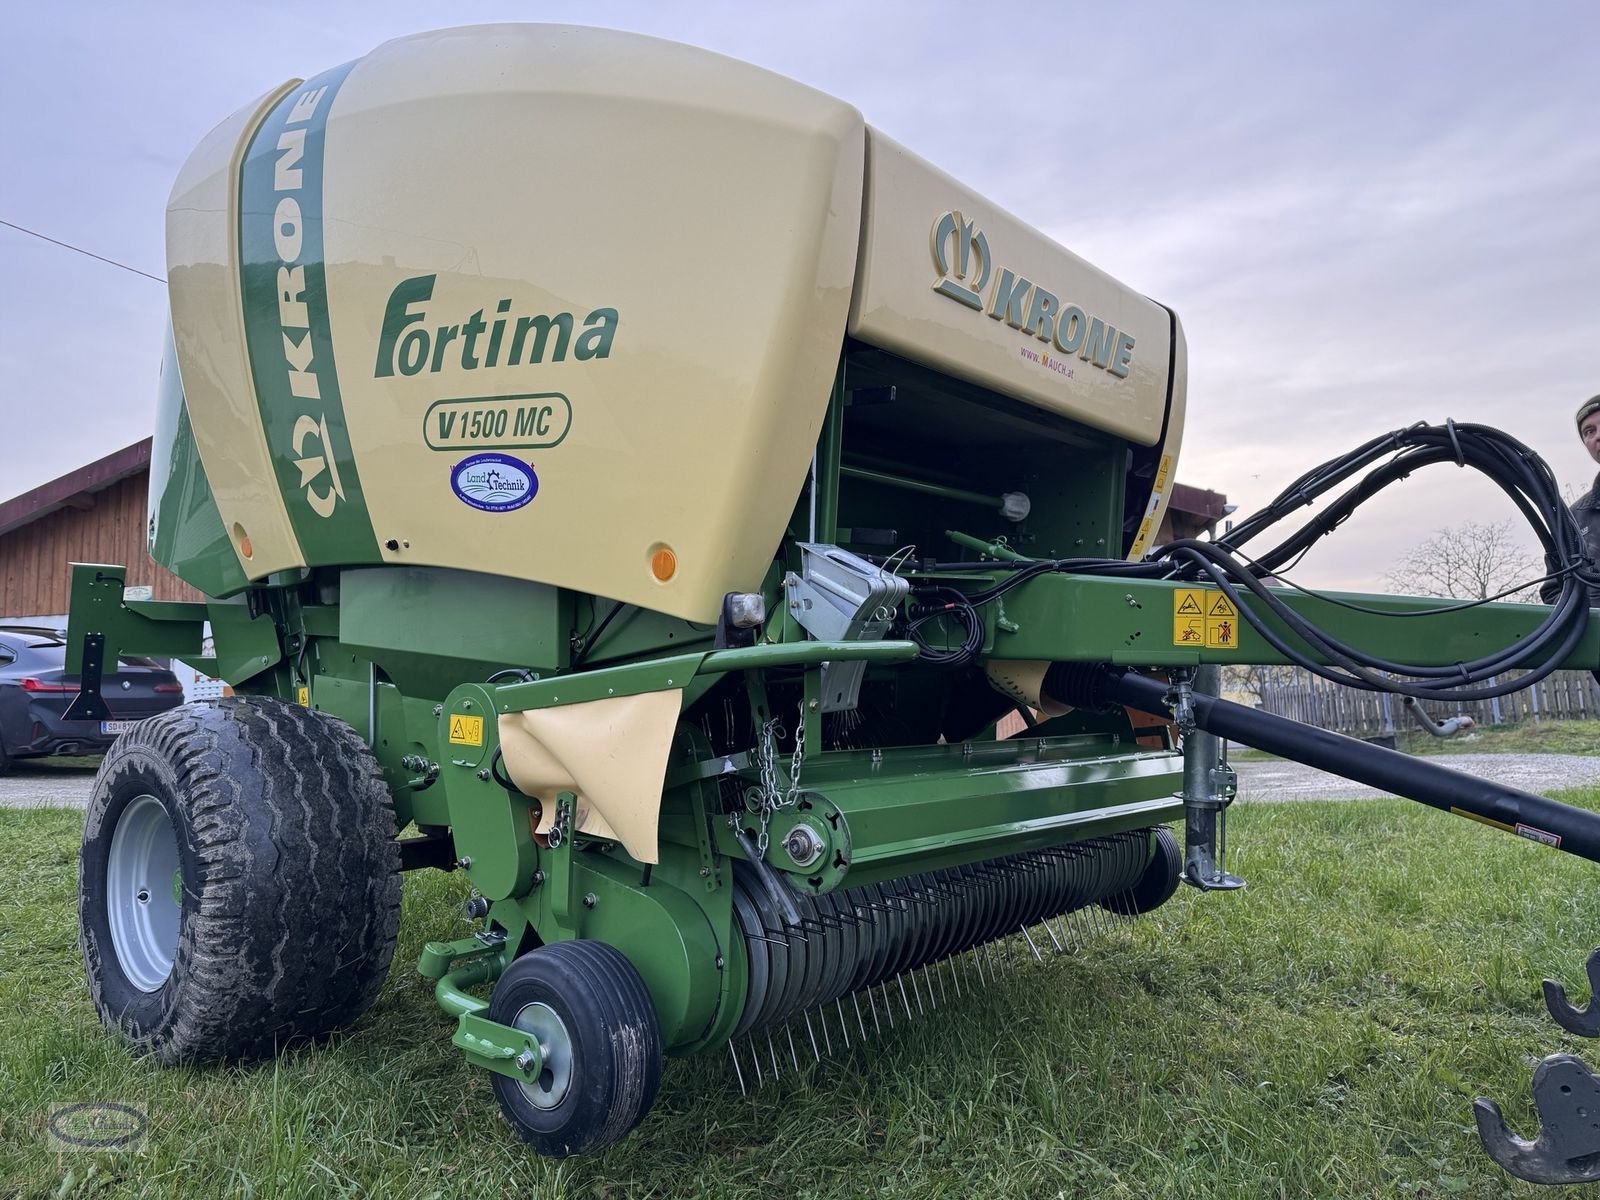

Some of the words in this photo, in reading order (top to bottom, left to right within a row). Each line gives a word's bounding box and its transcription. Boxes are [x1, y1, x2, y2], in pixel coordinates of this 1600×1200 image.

[273, 85, 328, 399] KRONE
[374, 274, 619, 378] Fortima
[987, 266, 1136, 379] KRONE
[438, 411, 457, 439] V
[461, 409, 508, 438] 1500
[513, 406, 553, 437] MC
[466, 471, 486, 483] Land
[493, 478, 525, 491] Technik
